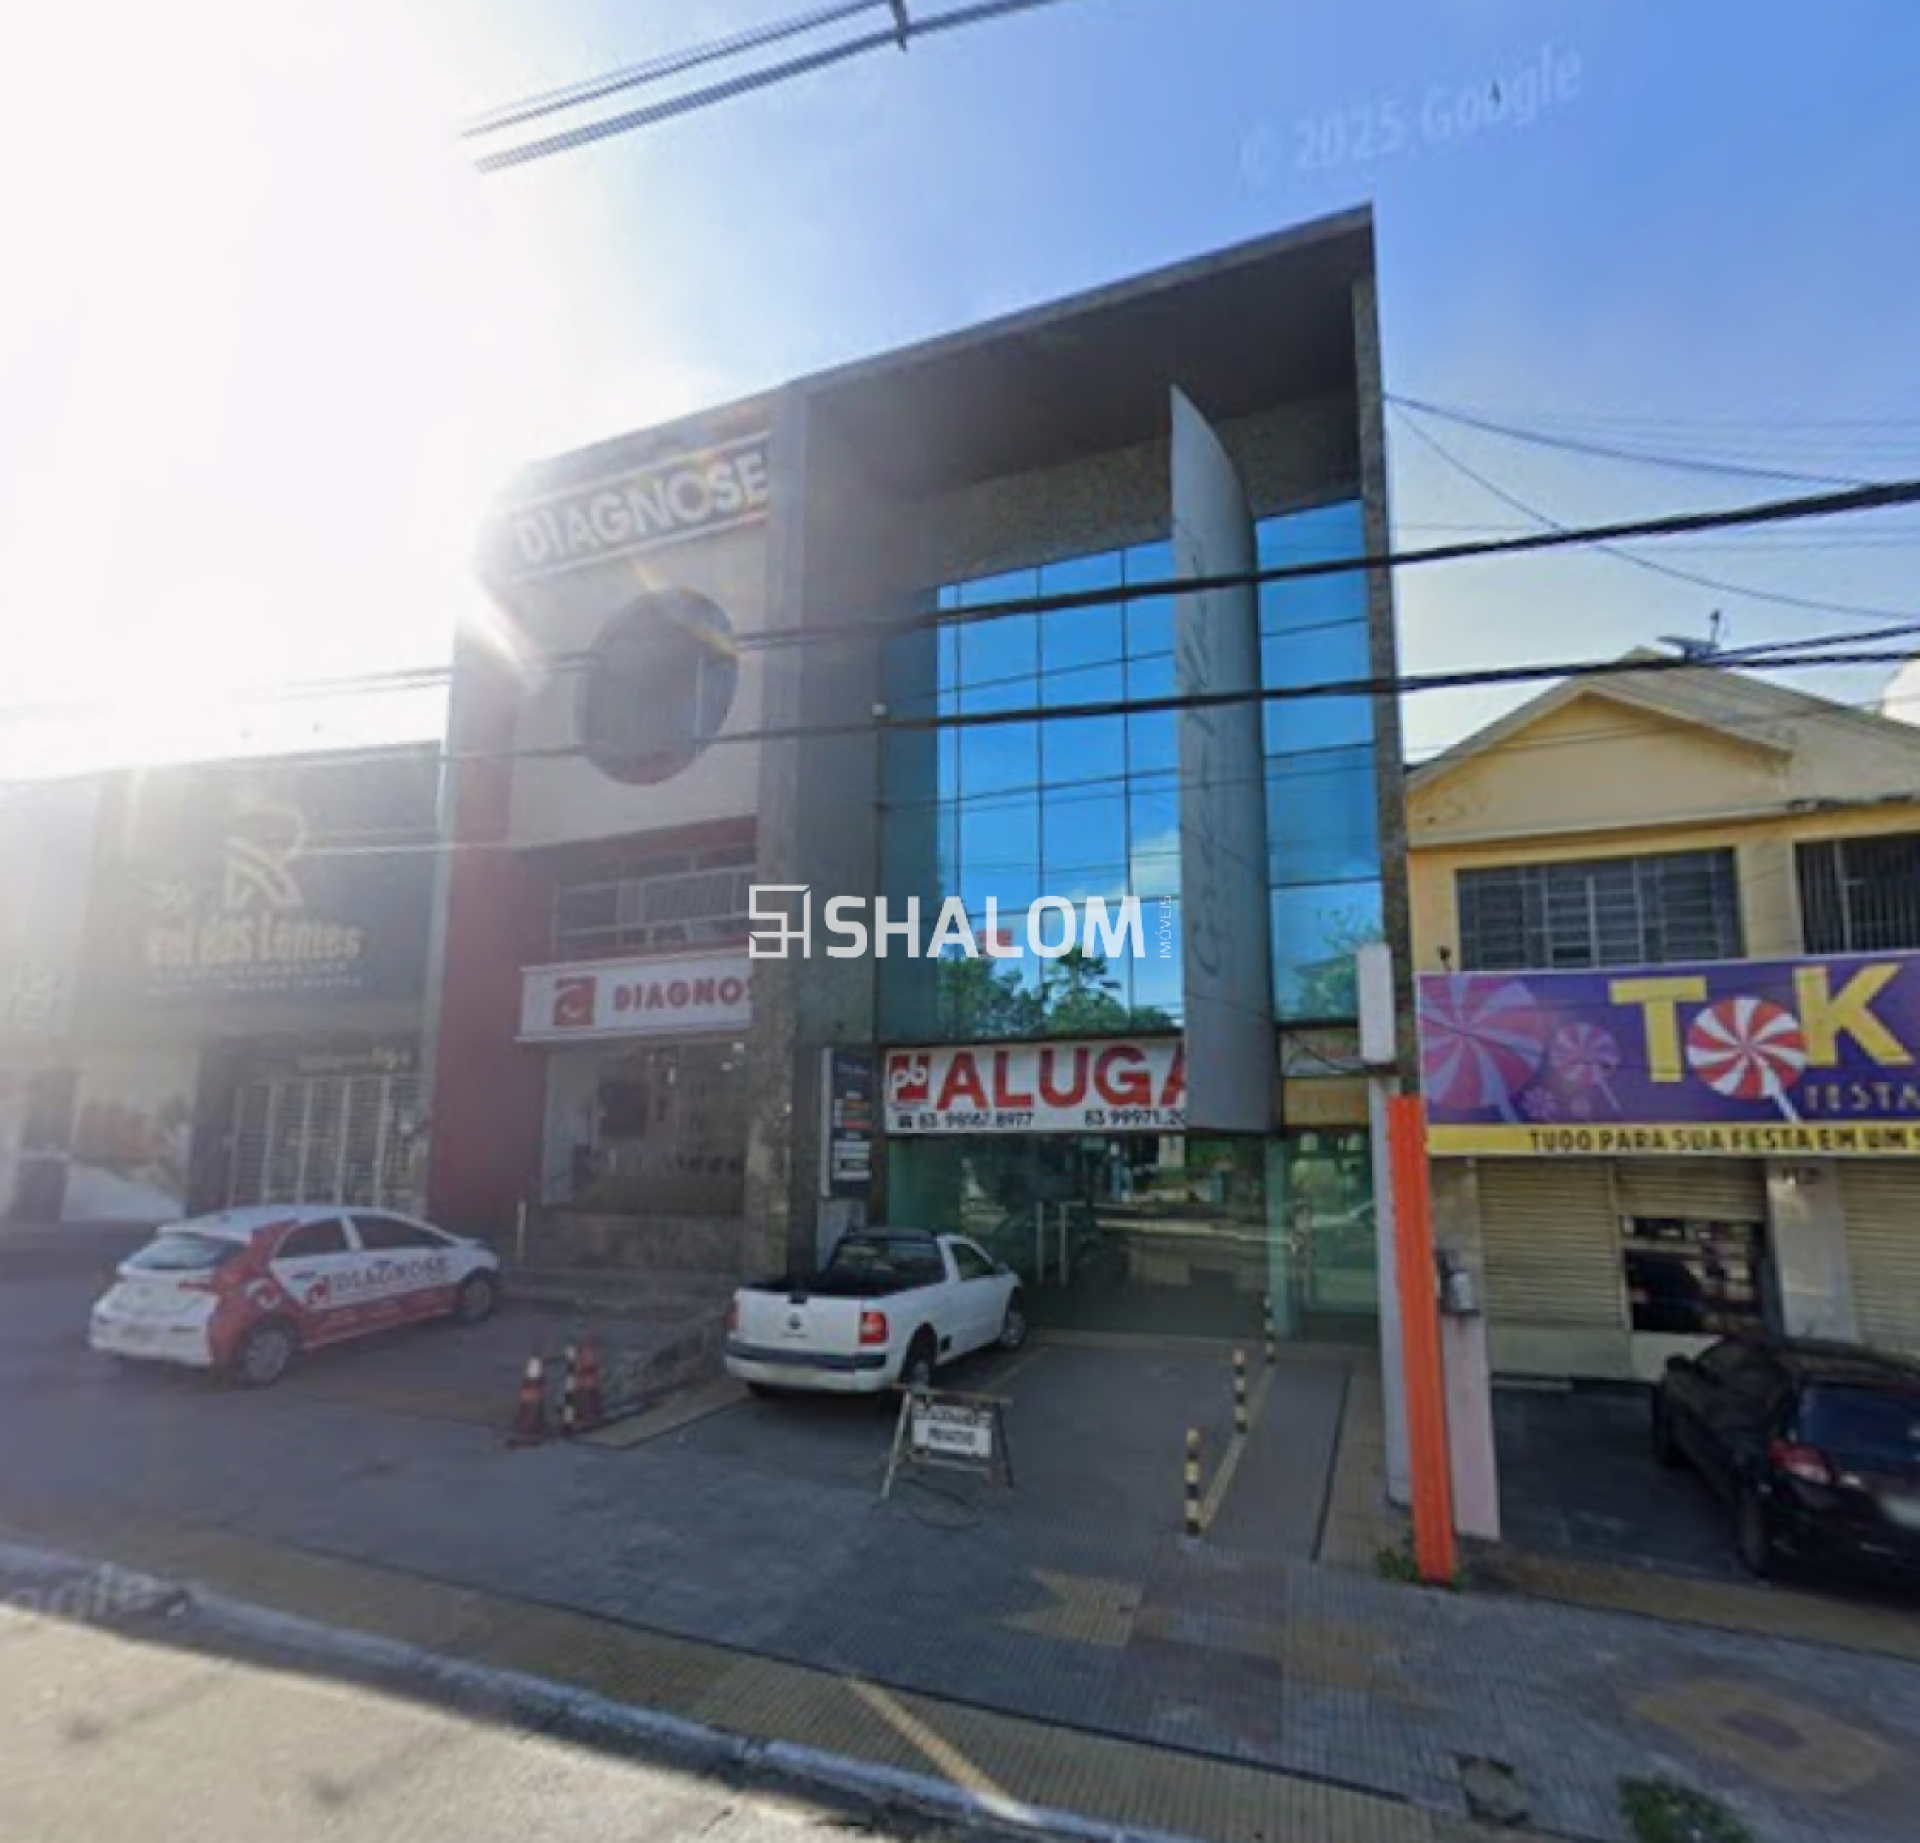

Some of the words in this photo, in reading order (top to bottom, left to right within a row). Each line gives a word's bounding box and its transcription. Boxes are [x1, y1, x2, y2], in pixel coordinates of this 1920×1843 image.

[511, 449, 768, 562] DIAGNOSE
[612, 975, 751, 1012] DIAGNO
[1529, 1130, 1591, 1150] TUDO
[1599, 1130, 1664, 1150] PARA
[1673, 1130, 1725, 1150] SUA
[1731, 1129, 1811, 1149] FESTA
[1818, 1129, 1856, 1148] EM
